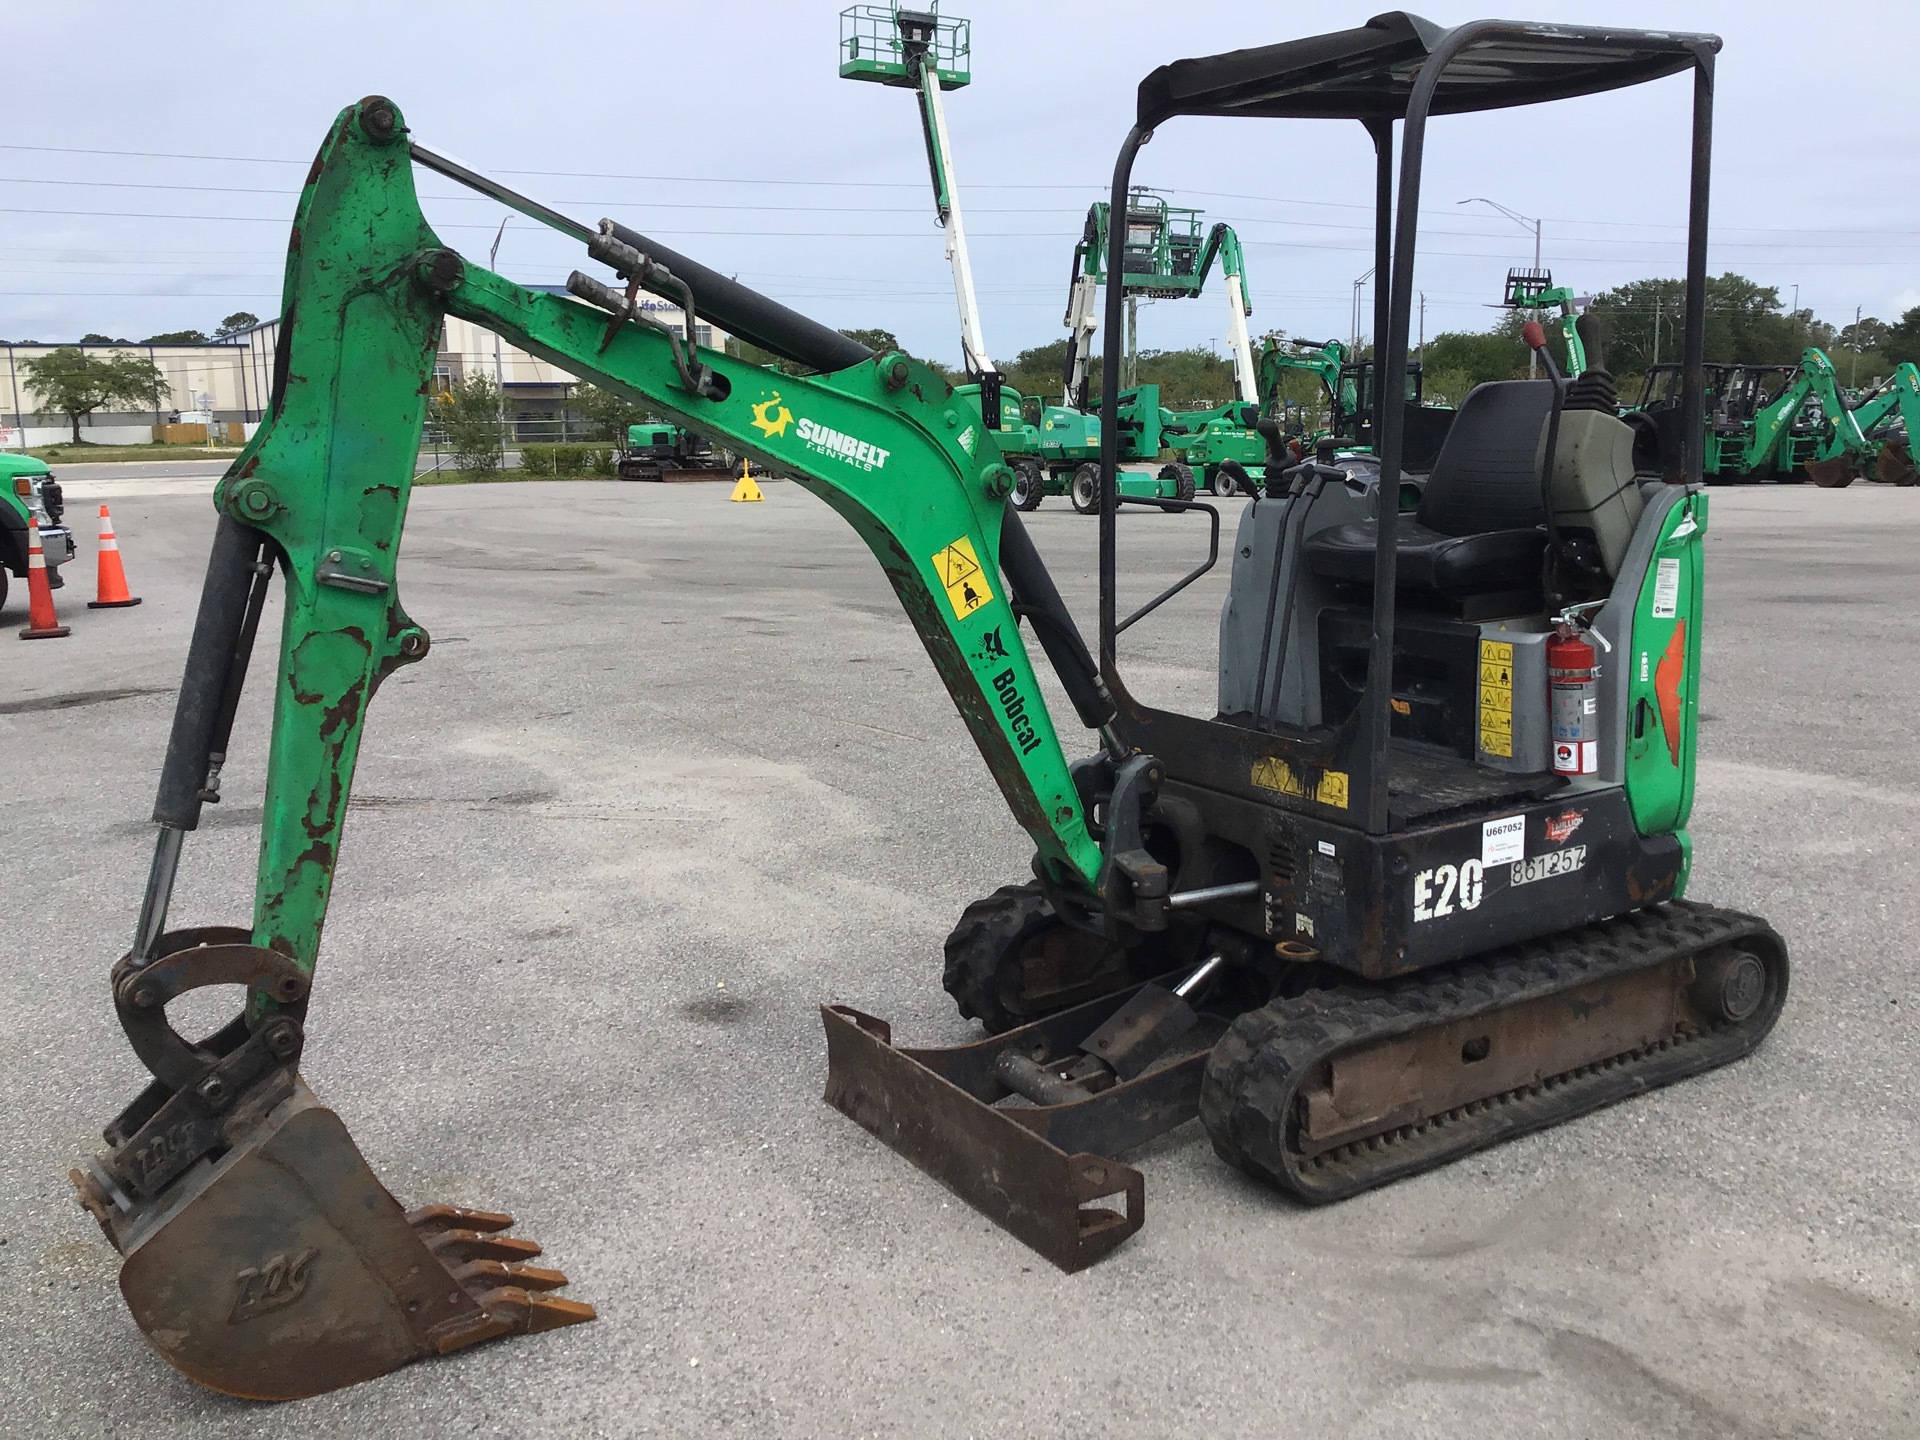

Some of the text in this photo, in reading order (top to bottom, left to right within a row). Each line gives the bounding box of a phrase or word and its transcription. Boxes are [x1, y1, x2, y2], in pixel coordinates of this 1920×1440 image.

[796, 417, 890, 469] SUNBELT
[991, 666, 1043, 757] Bobcat
[1583, 697, 1597, 715] E
[1486, 821, 1523, 837] U667052
[1512, 846, 1584, 885] 861257
[1413, 858, 1484, 923] E20
